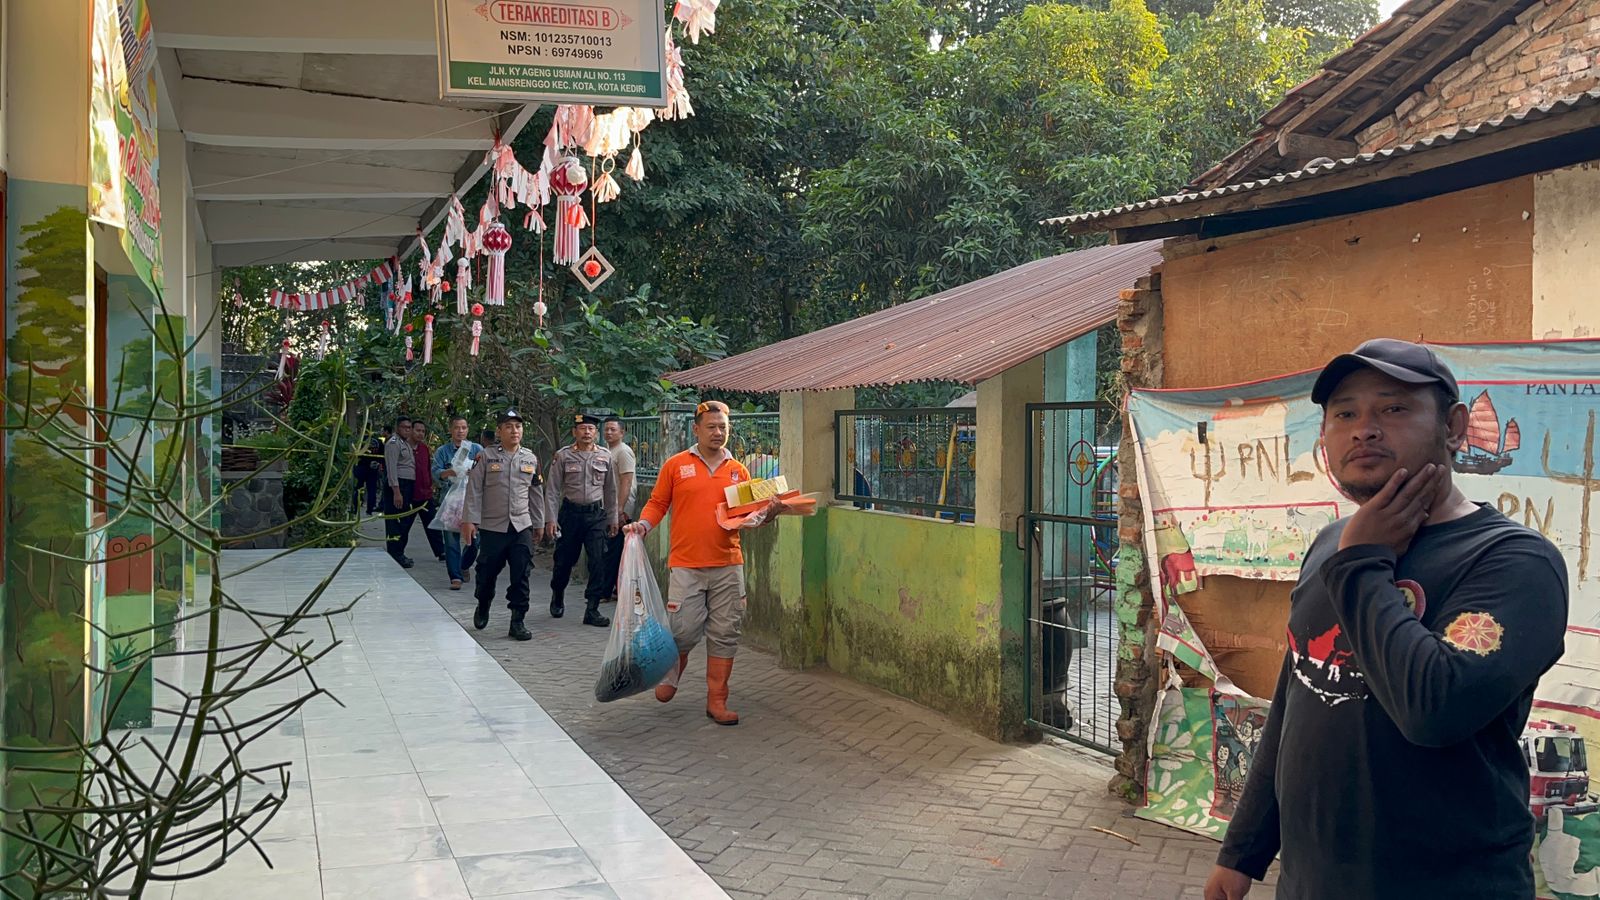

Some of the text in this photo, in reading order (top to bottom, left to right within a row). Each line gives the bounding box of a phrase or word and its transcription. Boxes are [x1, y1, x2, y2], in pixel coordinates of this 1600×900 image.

[498, 3, 611, 28] TERAKREDITASI B
[500, 30, 612, 47] NSM: 101235710013
[508, 44, 541, 56] NPSN
[551, 47, 603, 60] 69749696
[489, 66, 626, 81] JLN. KY AGENG USMAN ALI NO. 113
[467, 76, 646, 93] KEL. MANISRENGGO KEC. KOTA, KOTA KEDIRI
[1526, 384, 1600, 395] PANTA
